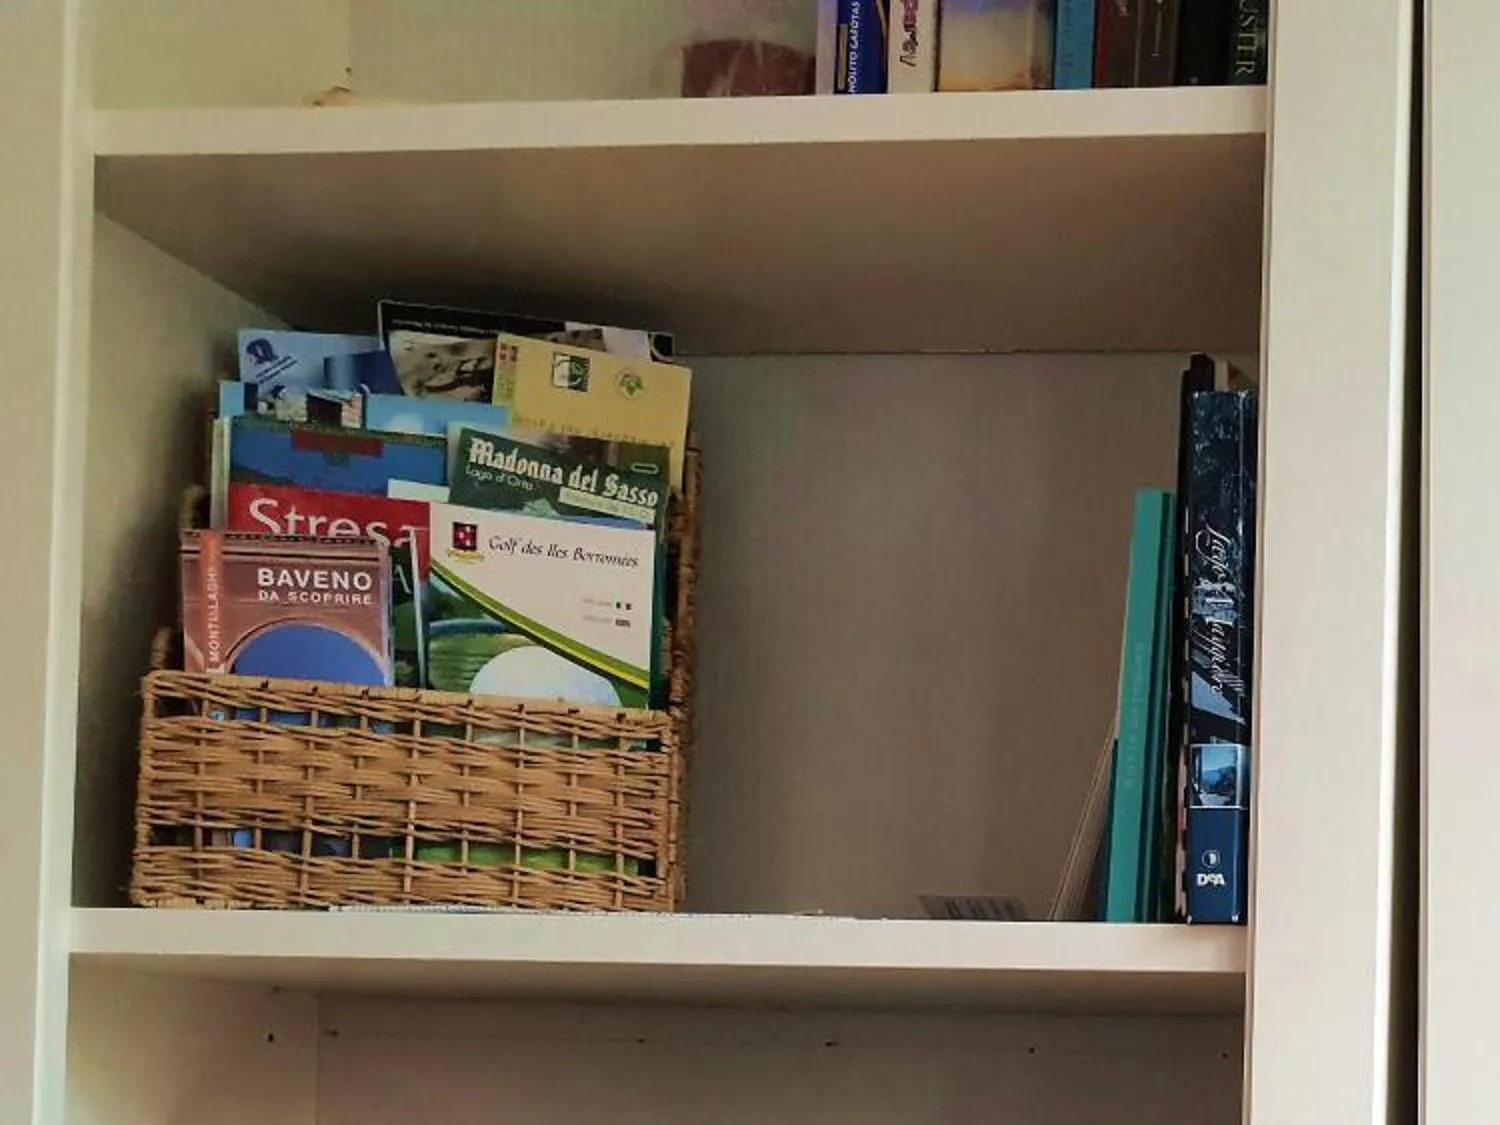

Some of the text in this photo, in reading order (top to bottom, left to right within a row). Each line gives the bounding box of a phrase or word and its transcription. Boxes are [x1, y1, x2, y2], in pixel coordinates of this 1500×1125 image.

[469, 437, 659, 507] Madonna del Sasso
[250, 497, 416, 546] Stresa
[489, 535, 517, 554] Golf
[521, 540, 544, 555] des
[257, 567, 372, 591] BAVENO
[258, 591, 372, 606] DA SCOPRIRE
